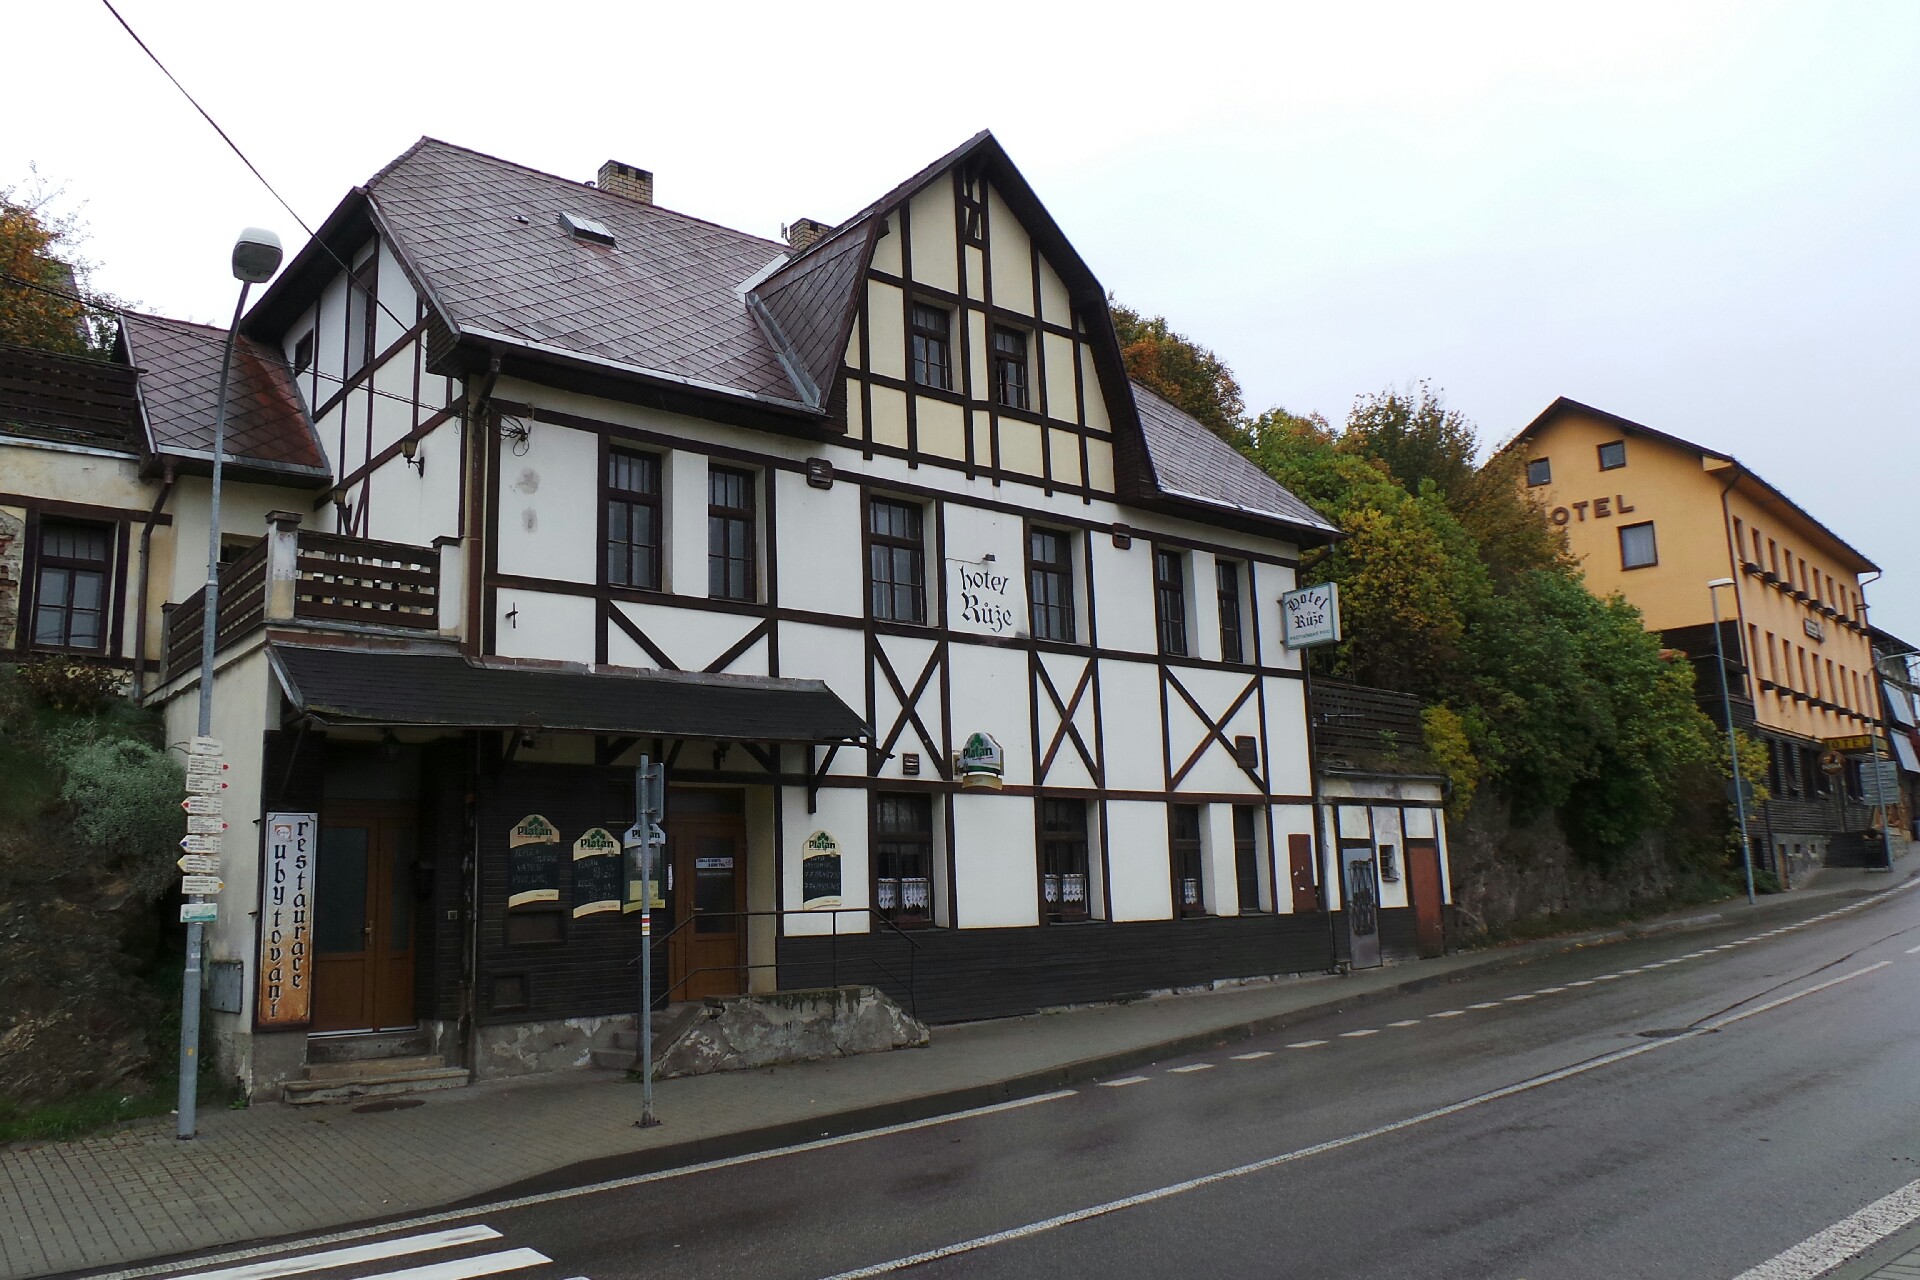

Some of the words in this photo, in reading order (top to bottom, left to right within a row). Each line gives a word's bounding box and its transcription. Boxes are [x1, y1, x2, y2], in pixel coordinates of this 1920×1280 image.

[1552, 494, 1634, 525] OTEL
[959, 565, 1009, 595] hotel
[961, 592, 1012, 633] Růže
[963, 746, 993, 759] Platan
[517, 826, 552, 836] Platan
[632, 829, 661, 839] Plan
[580, 838, 614, 848] Platan
[809, 839, 836, 849] Platan
[291, 821, 309, 988] restaurace
[268, 844, 287, 1018] ubytování
